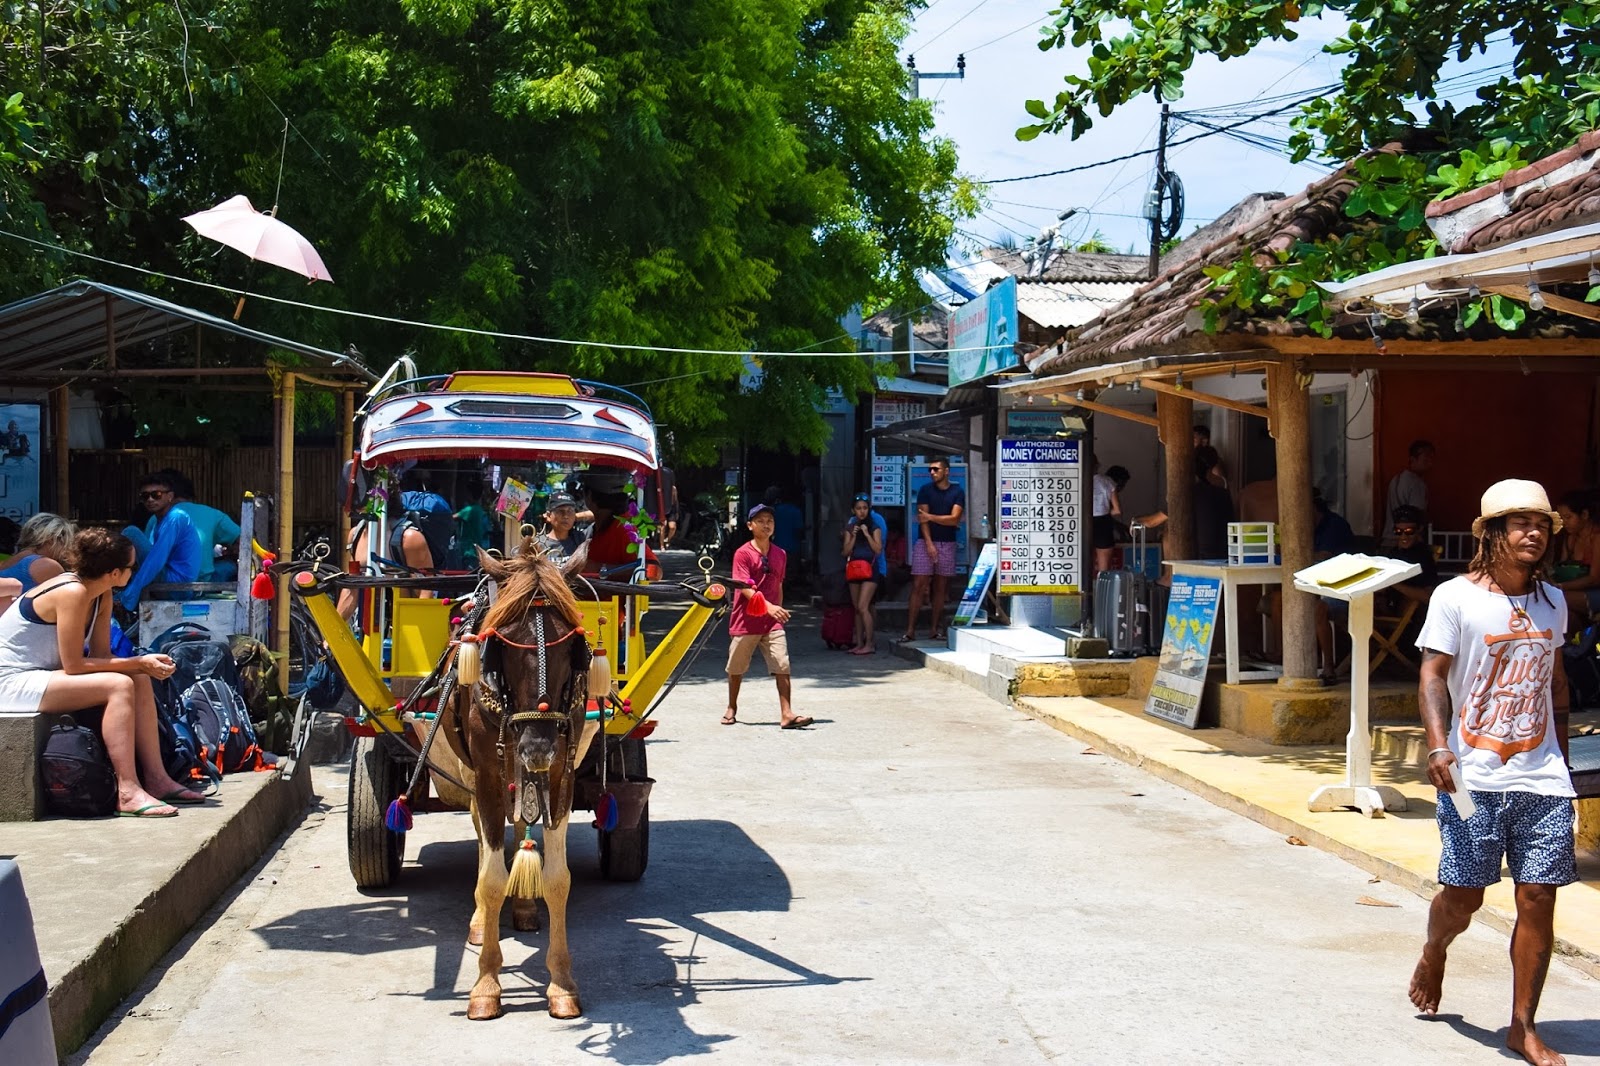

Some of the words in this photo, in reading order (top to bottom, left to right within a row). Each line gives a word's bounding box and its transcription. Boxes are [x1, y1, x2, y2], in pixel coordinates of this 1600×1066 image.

[749, 375, 767, 384] AT
[1002, 448, 1033, 460] MONEY
[1035, 448, 1078, 460] CHANGER
[1012, 480, 1029, 489] USD
[1012, 494, 1029, 502] AUD
[1012, 507, 1029, 516] EUR
[1012, 521, 1028, 530] GBP
[1012, 534, 1029, 543] YEN
[1012, 548, 1029, 556] SGD
[1012, 561, 1028, 570] CHF
[1011, 575, 1029, 584] MYR
